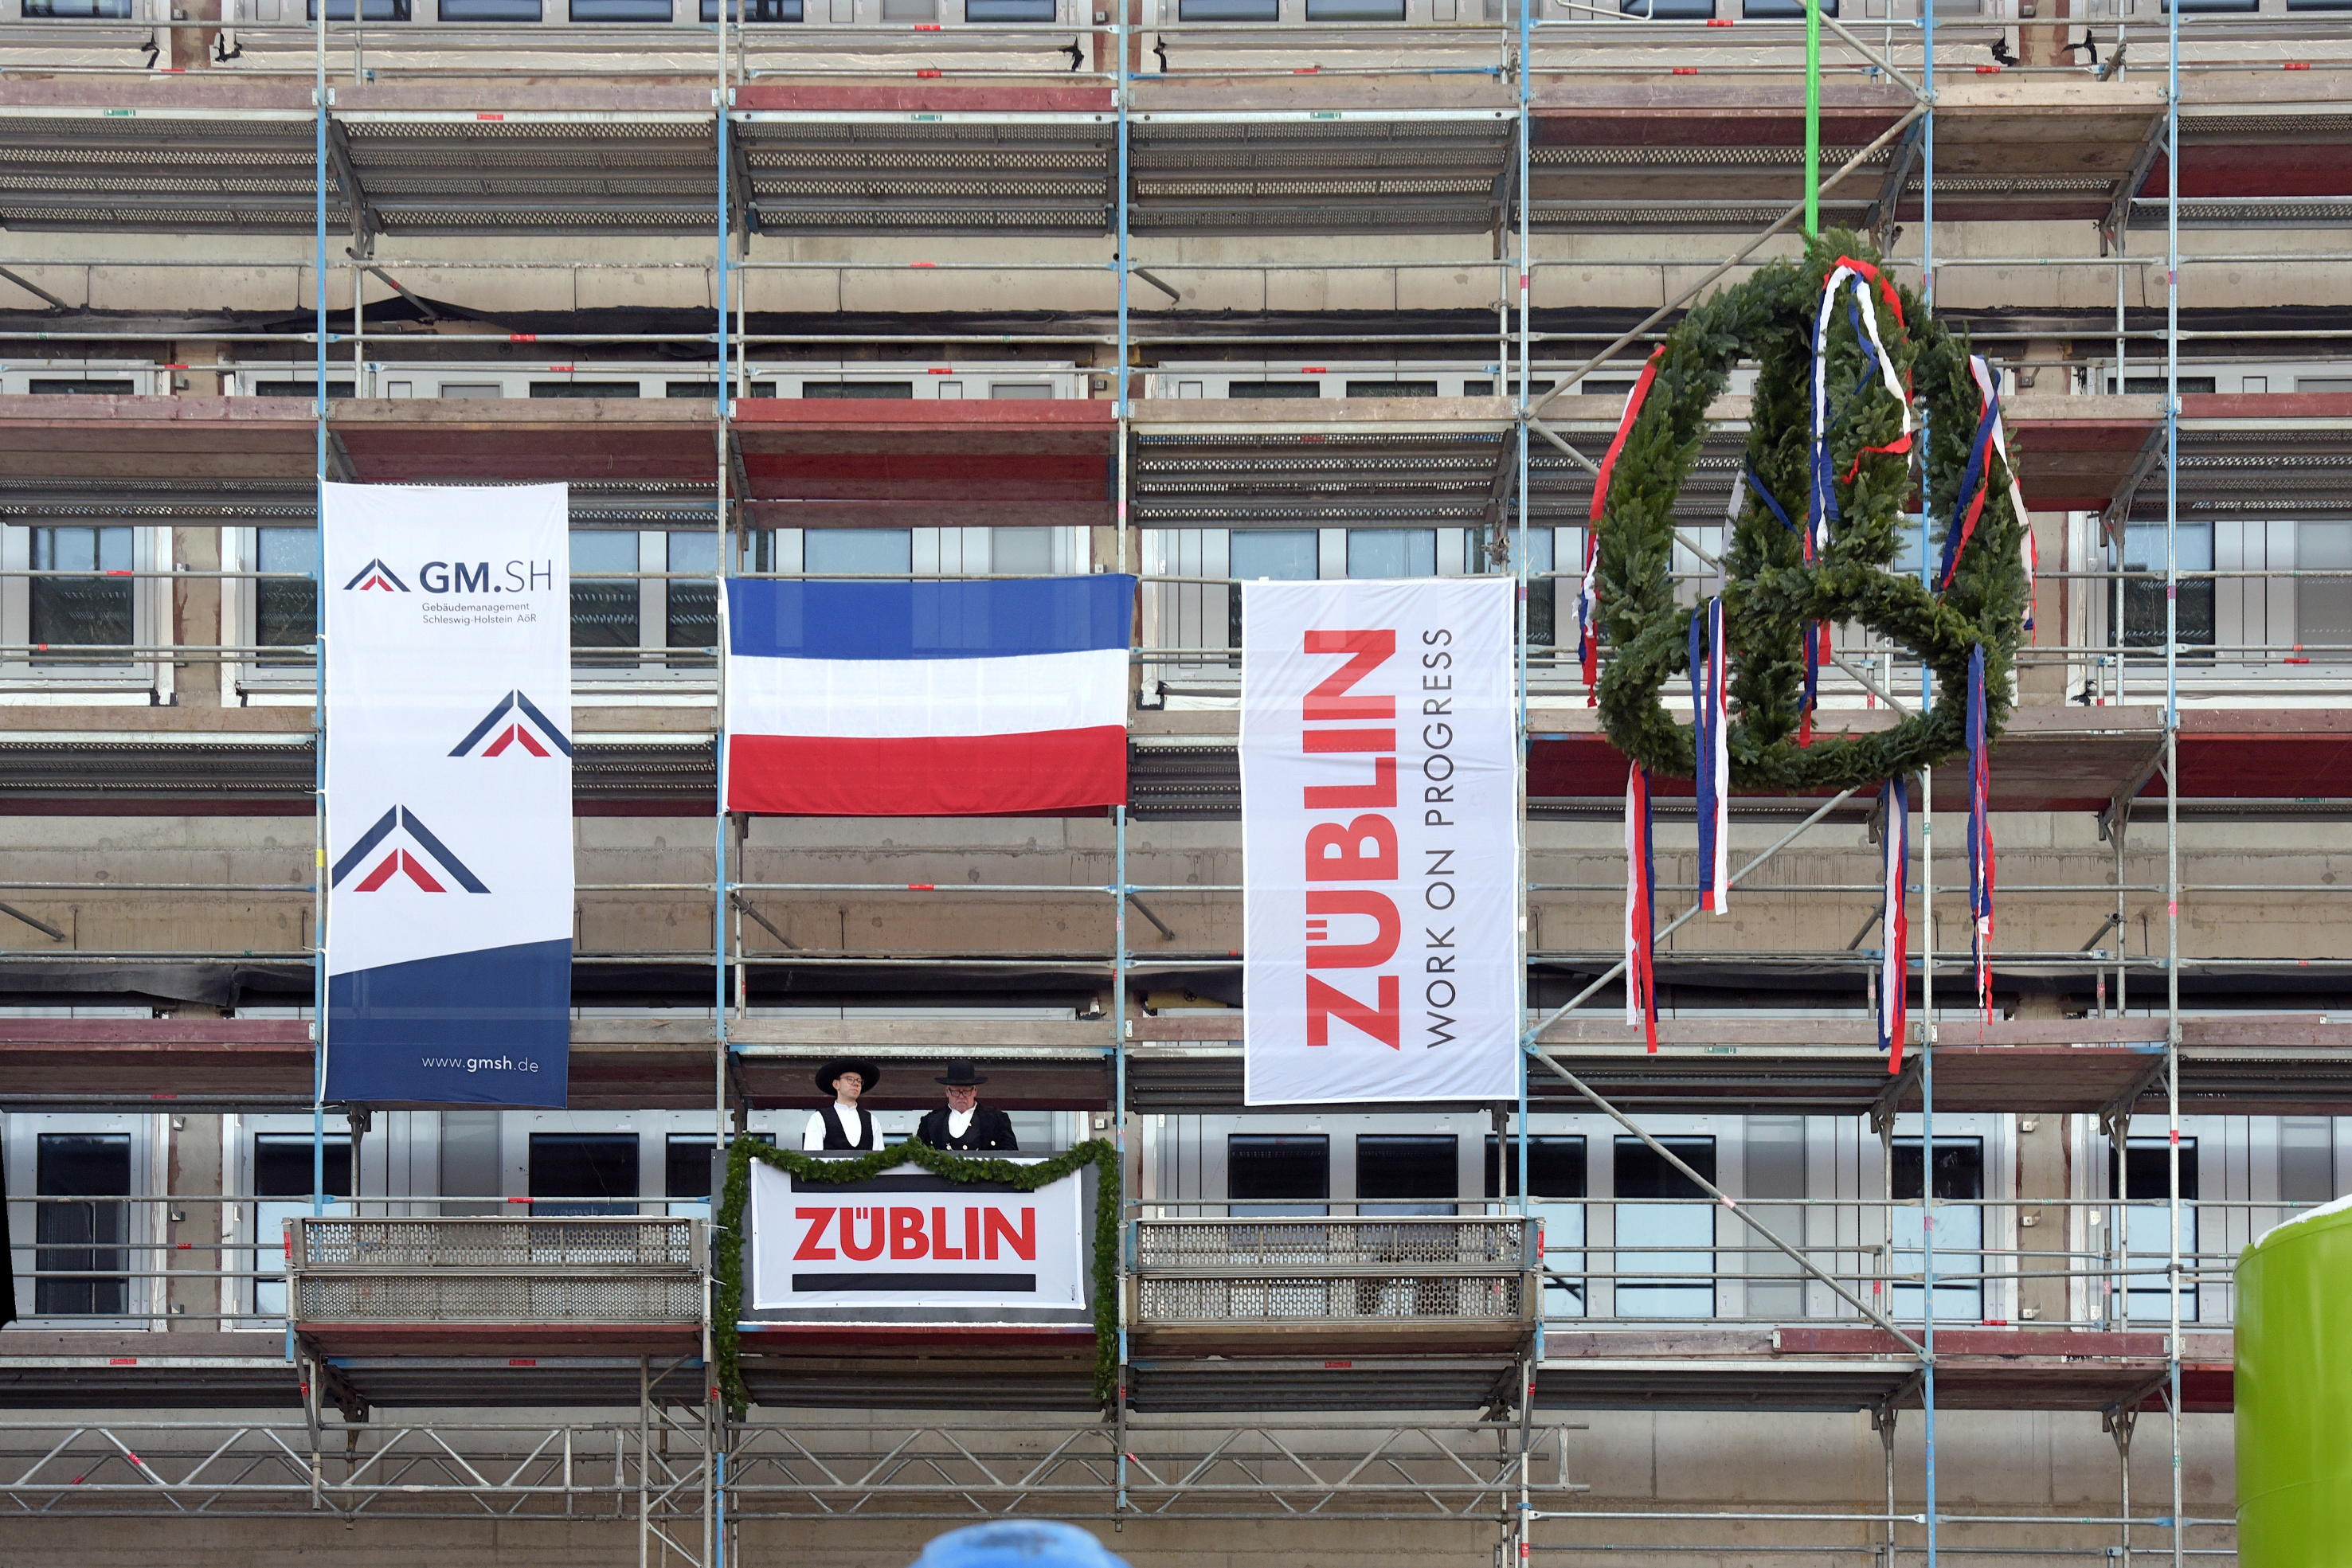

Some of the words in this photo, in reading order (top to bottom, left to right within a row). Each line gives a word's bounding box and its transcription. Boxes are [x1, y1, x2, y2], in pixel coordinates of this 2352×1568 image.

[419, 559, 551, 594] GM.SH
[421, 602, 530, 613] Gebäudemanagement
[422, 614, 513, 626] Schleswig-Holstein
[517, 613, 537, 623] AöR
[1423, 628, 1454, 826] PROGRESS
[1303, 629, 1402, 1051] ZÜBLIN
[1425, 850, 1455, 910] ON
[1426, 926, 1457, 1049] WORK
[421, 1055, 539, 1073] www.gmsh.de
[792, 1206, 1036, 1261] ZÜBLIN
